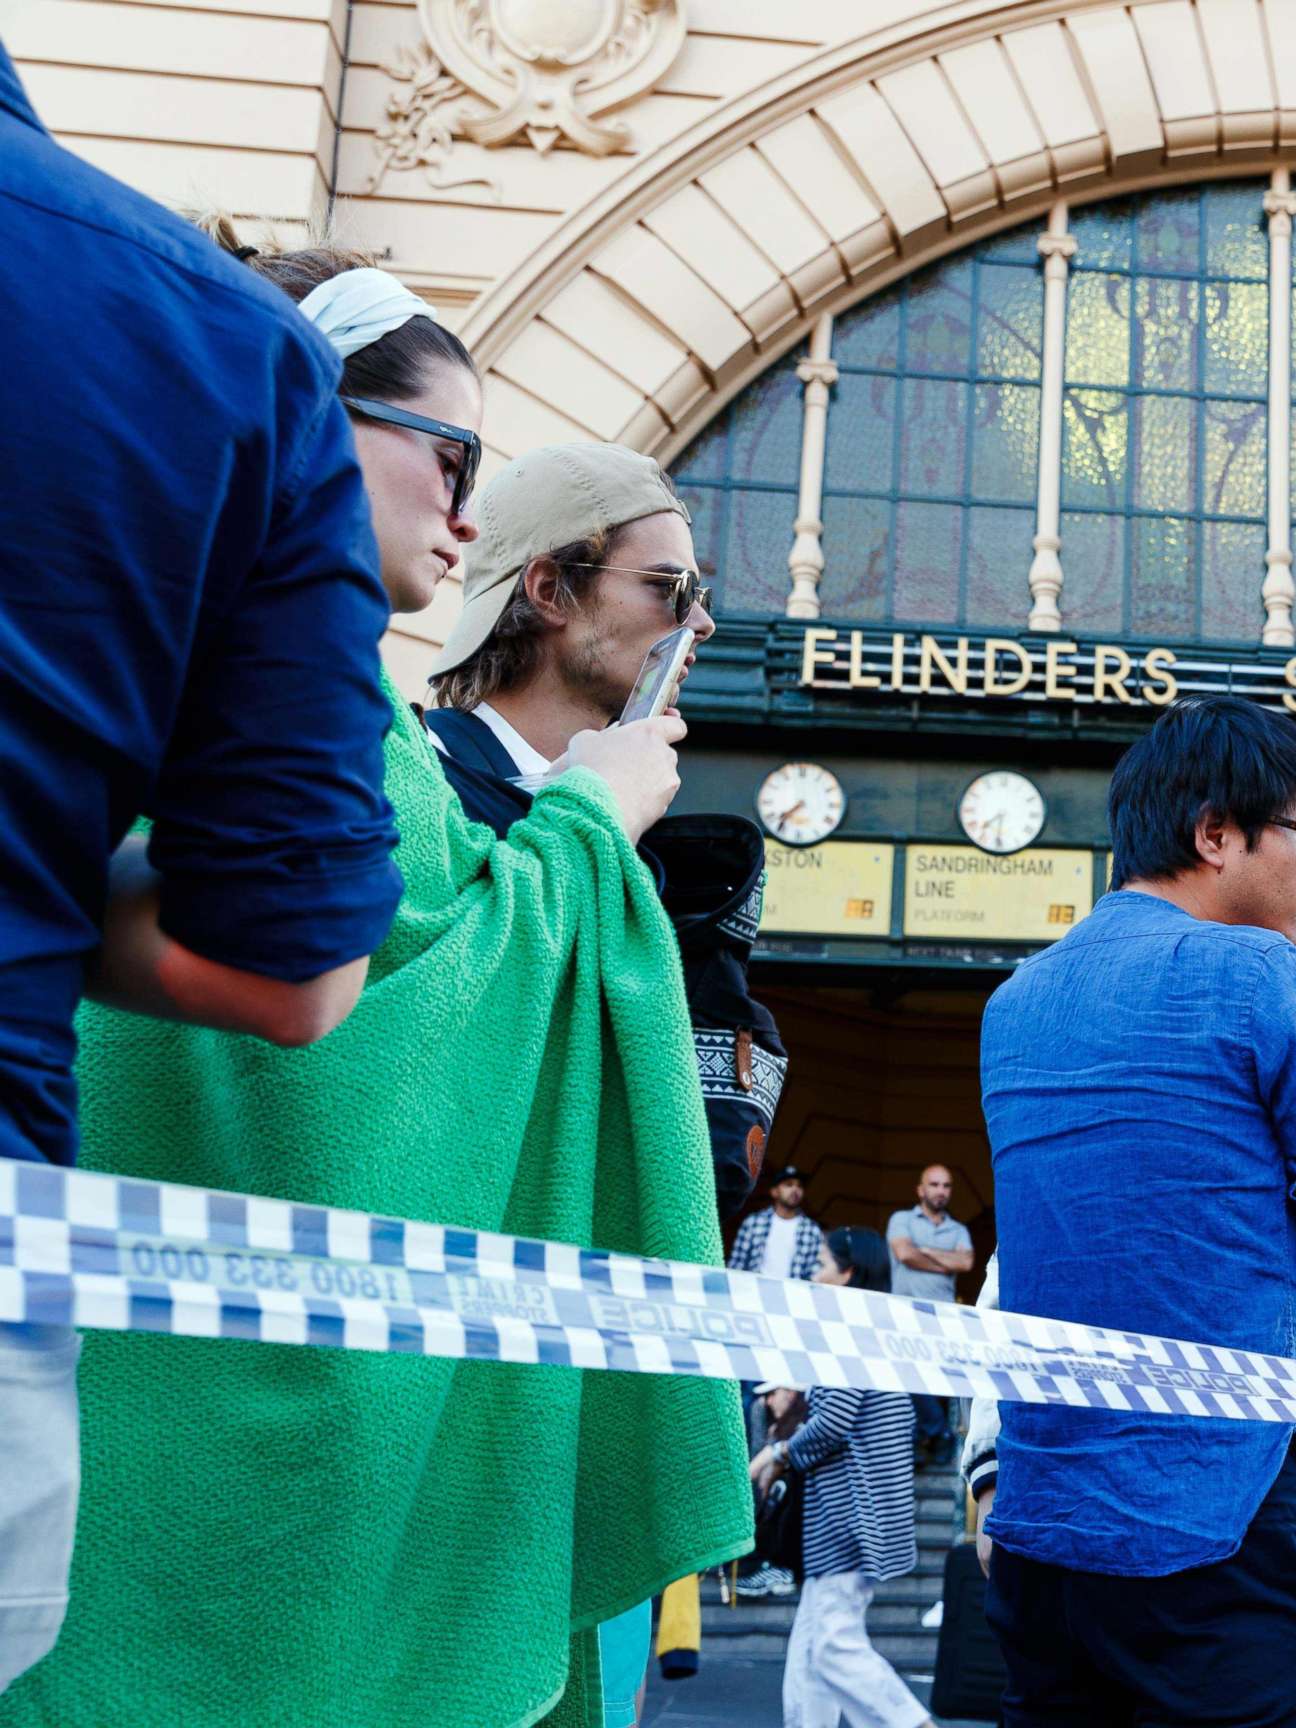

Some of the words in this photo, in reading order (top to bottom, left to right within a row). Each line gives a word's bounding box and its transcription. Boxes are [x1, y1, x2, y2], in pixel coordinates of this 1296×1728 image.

[800, 627, 1178, 706] FLINDERS
[915, 854, 1054, 876] SANDRINGHAM
[915, 879, 955, 899] LINE
[913, 907, 986, 923] PLATFORM
